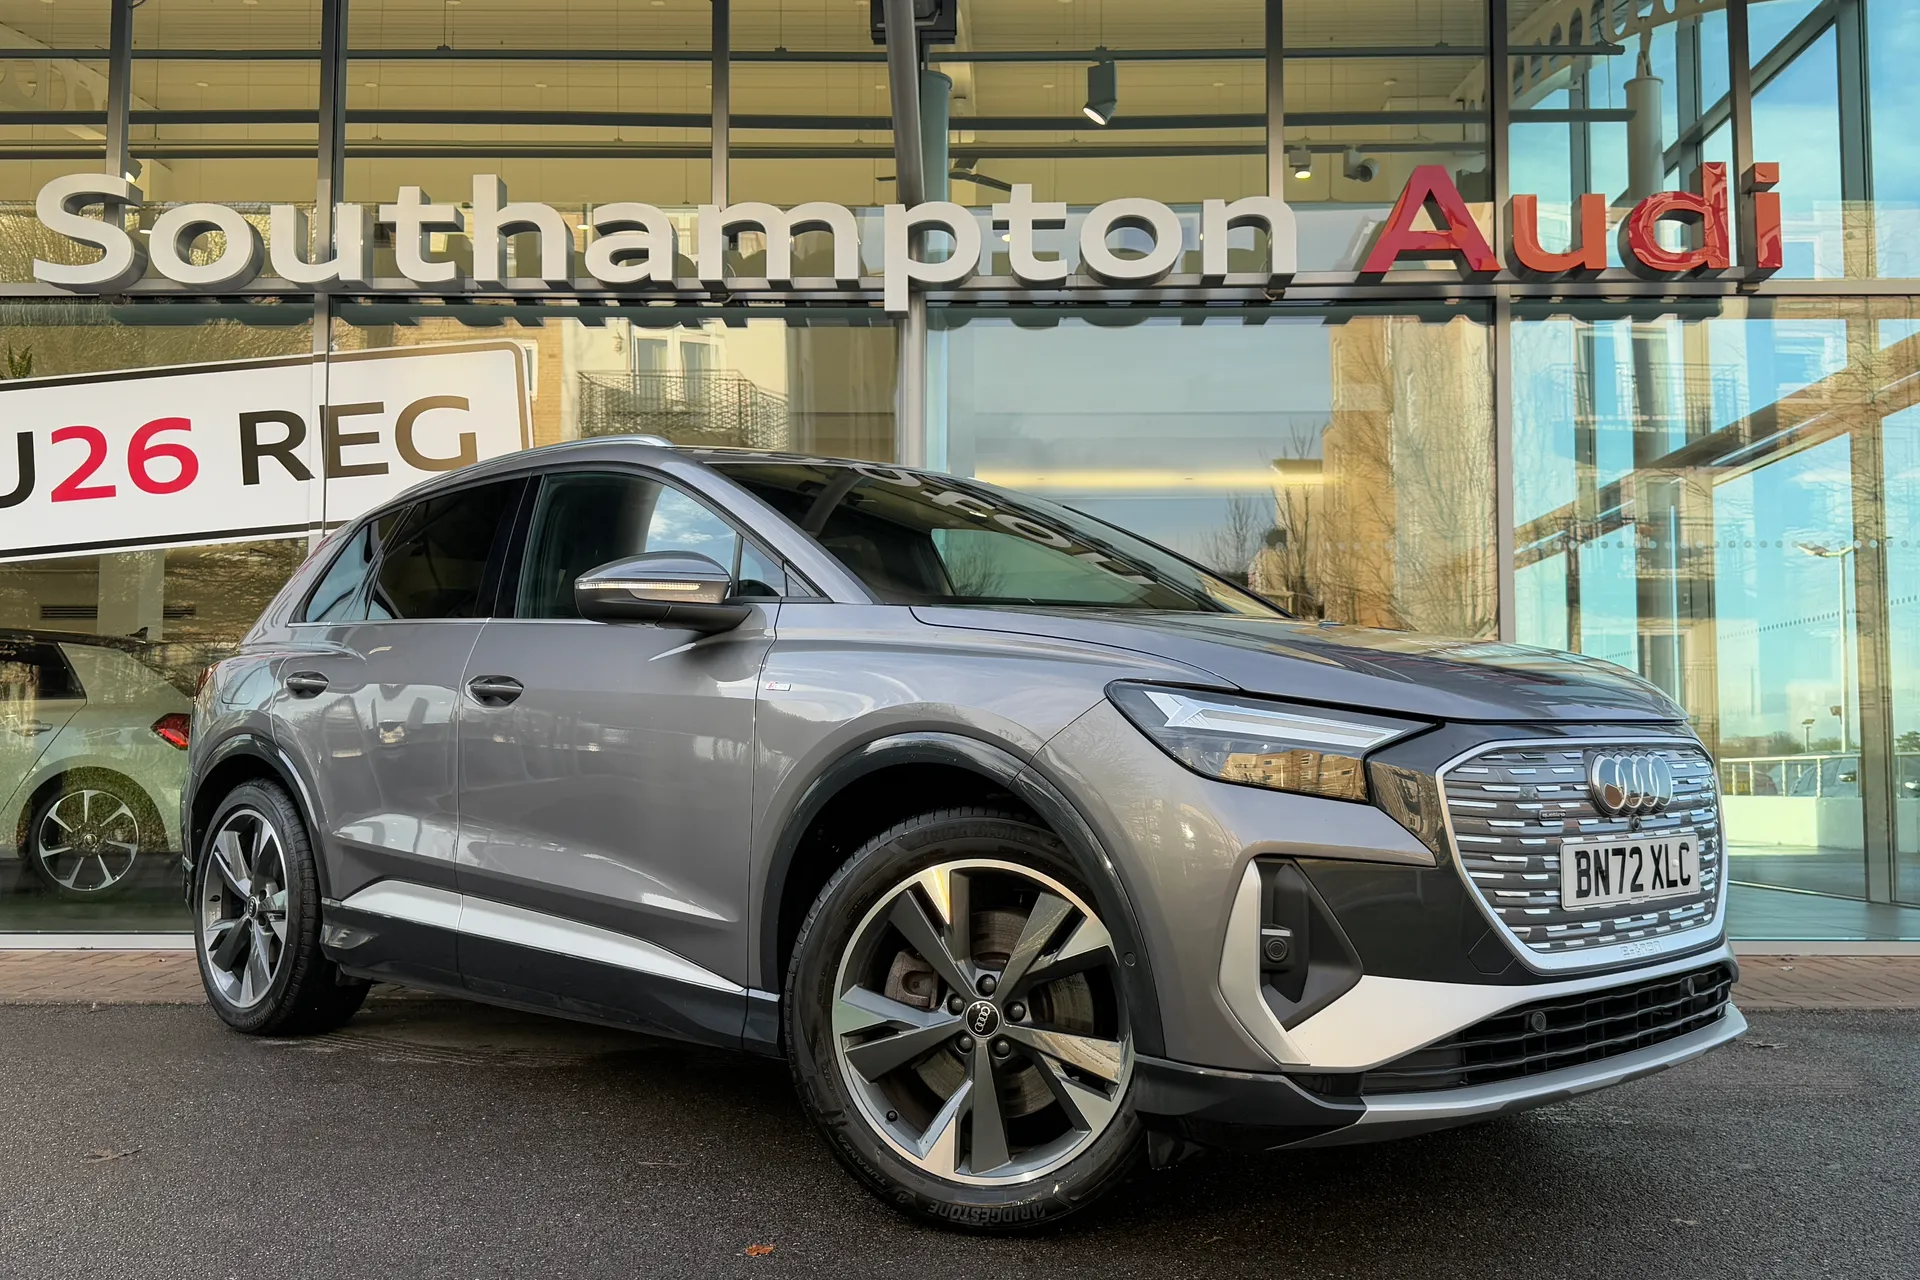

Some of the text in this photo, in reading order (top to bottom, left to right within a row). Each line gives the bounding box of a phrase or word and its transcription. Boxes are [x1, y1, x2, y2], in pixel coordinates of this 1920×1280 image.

[33, 160, 1783, 315] Southampton Audi
[239, 395, 479, 486] REG
[1574, 841, 1691, 899] BN72 XLC
[1620, 940, 1663, 958] e-tron
[837, 1134, 887, 1186] TURANZA
[927, 1200, 1047, 1223] BRIDGESTONE
